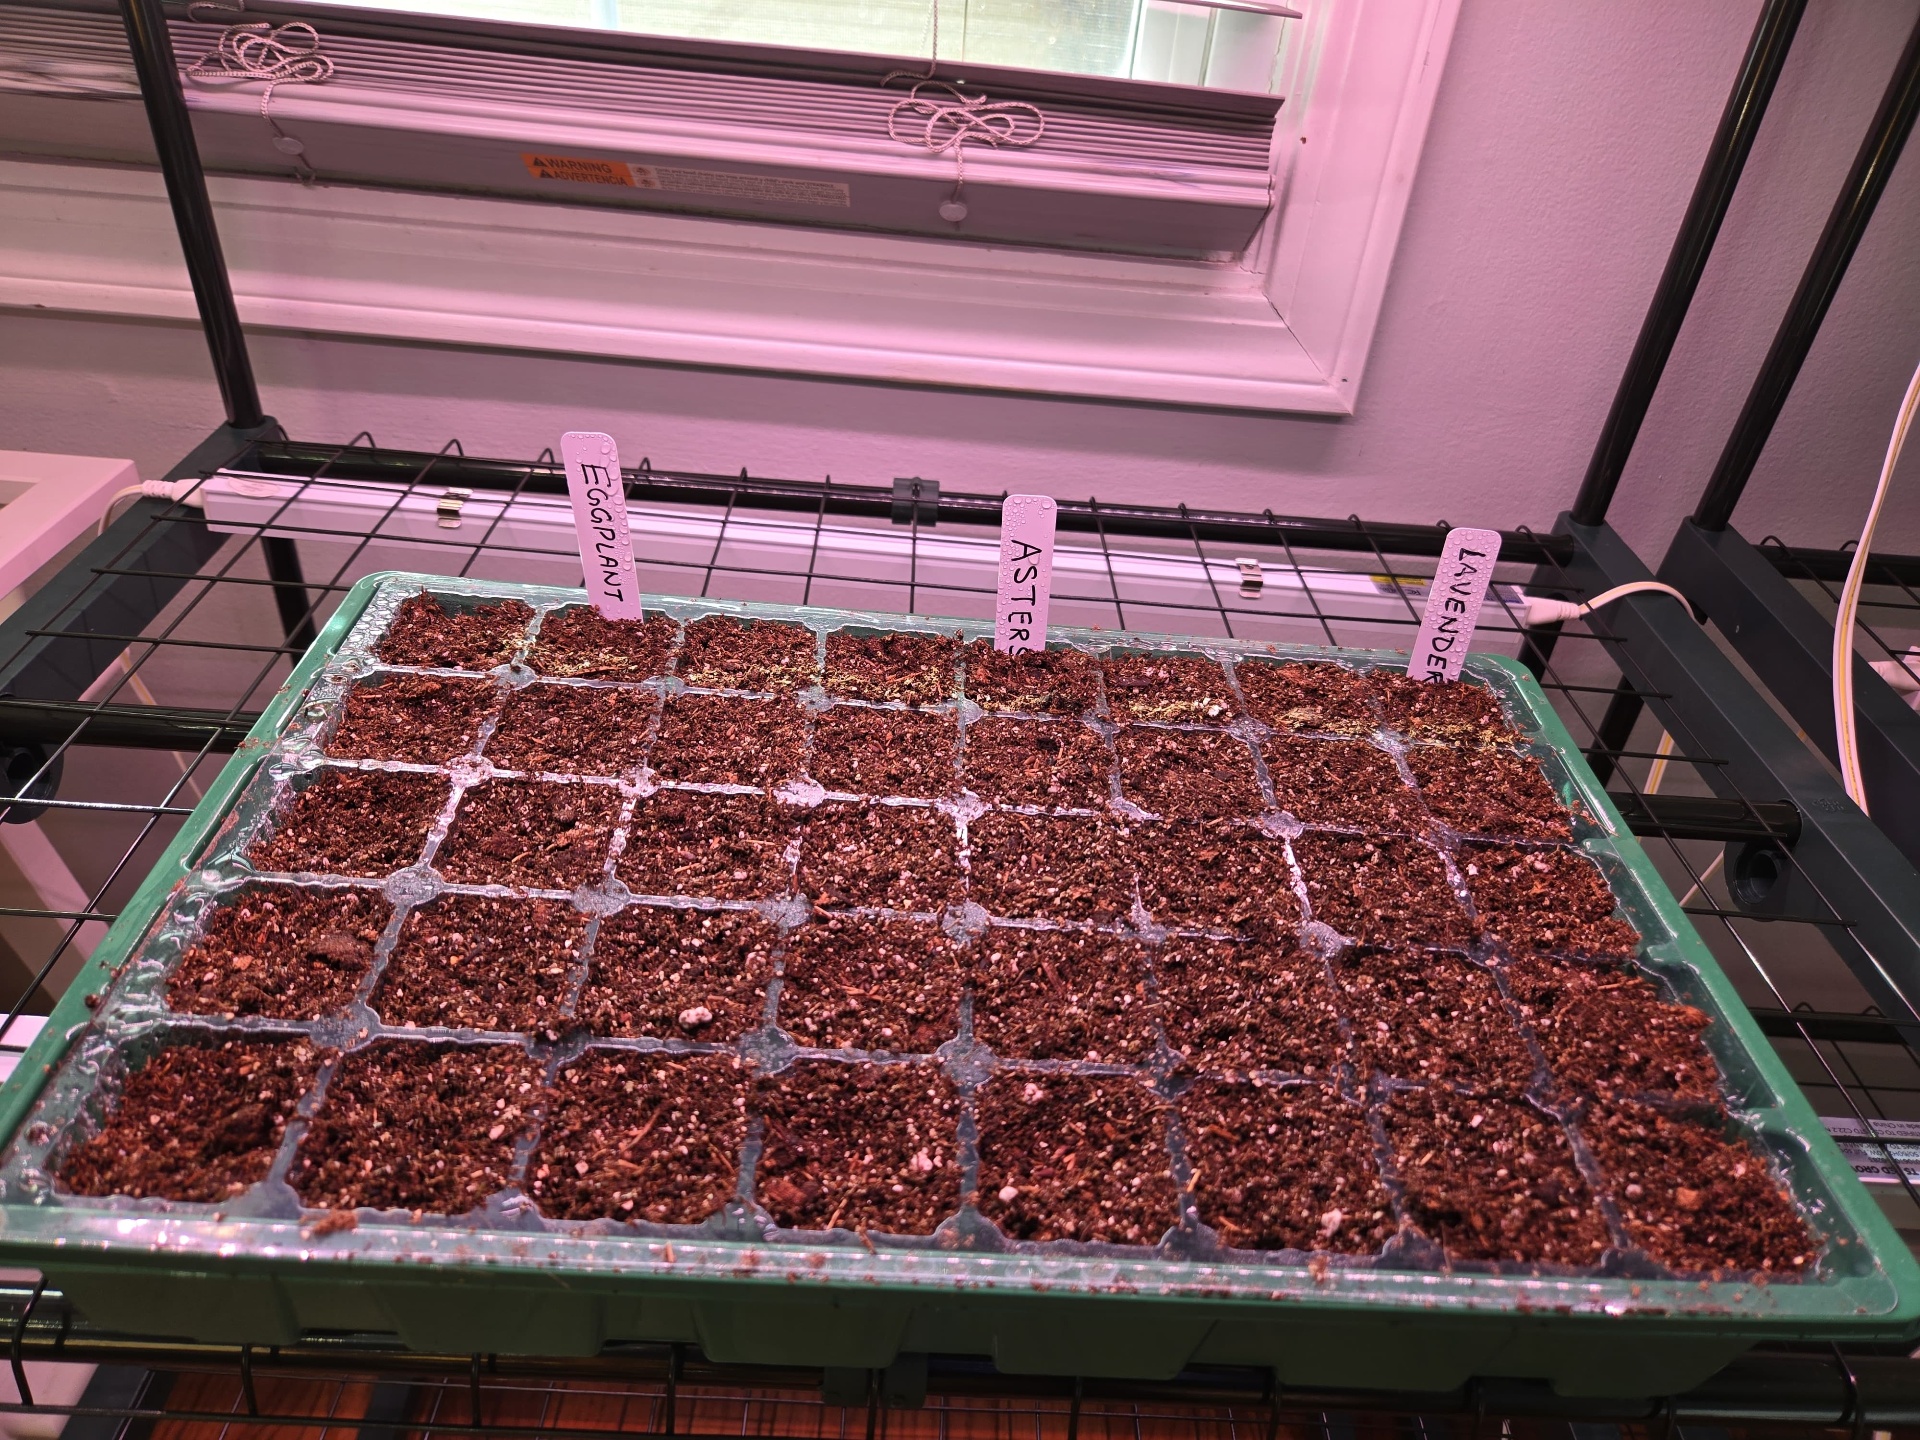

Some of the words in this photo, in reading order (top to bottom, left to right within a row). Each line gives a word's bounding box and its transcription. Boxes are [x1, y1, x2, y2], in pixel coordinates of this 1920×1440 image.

[544, 157, 613, 174] WARNING
[554, 169, 629, 187] ADVERTENCIA
[580, 463, 624, 602] EGGPLANT
[1423, 547, 1487, 684] LAVENDER
[1851, 1165, 1880, 1174] GRO
